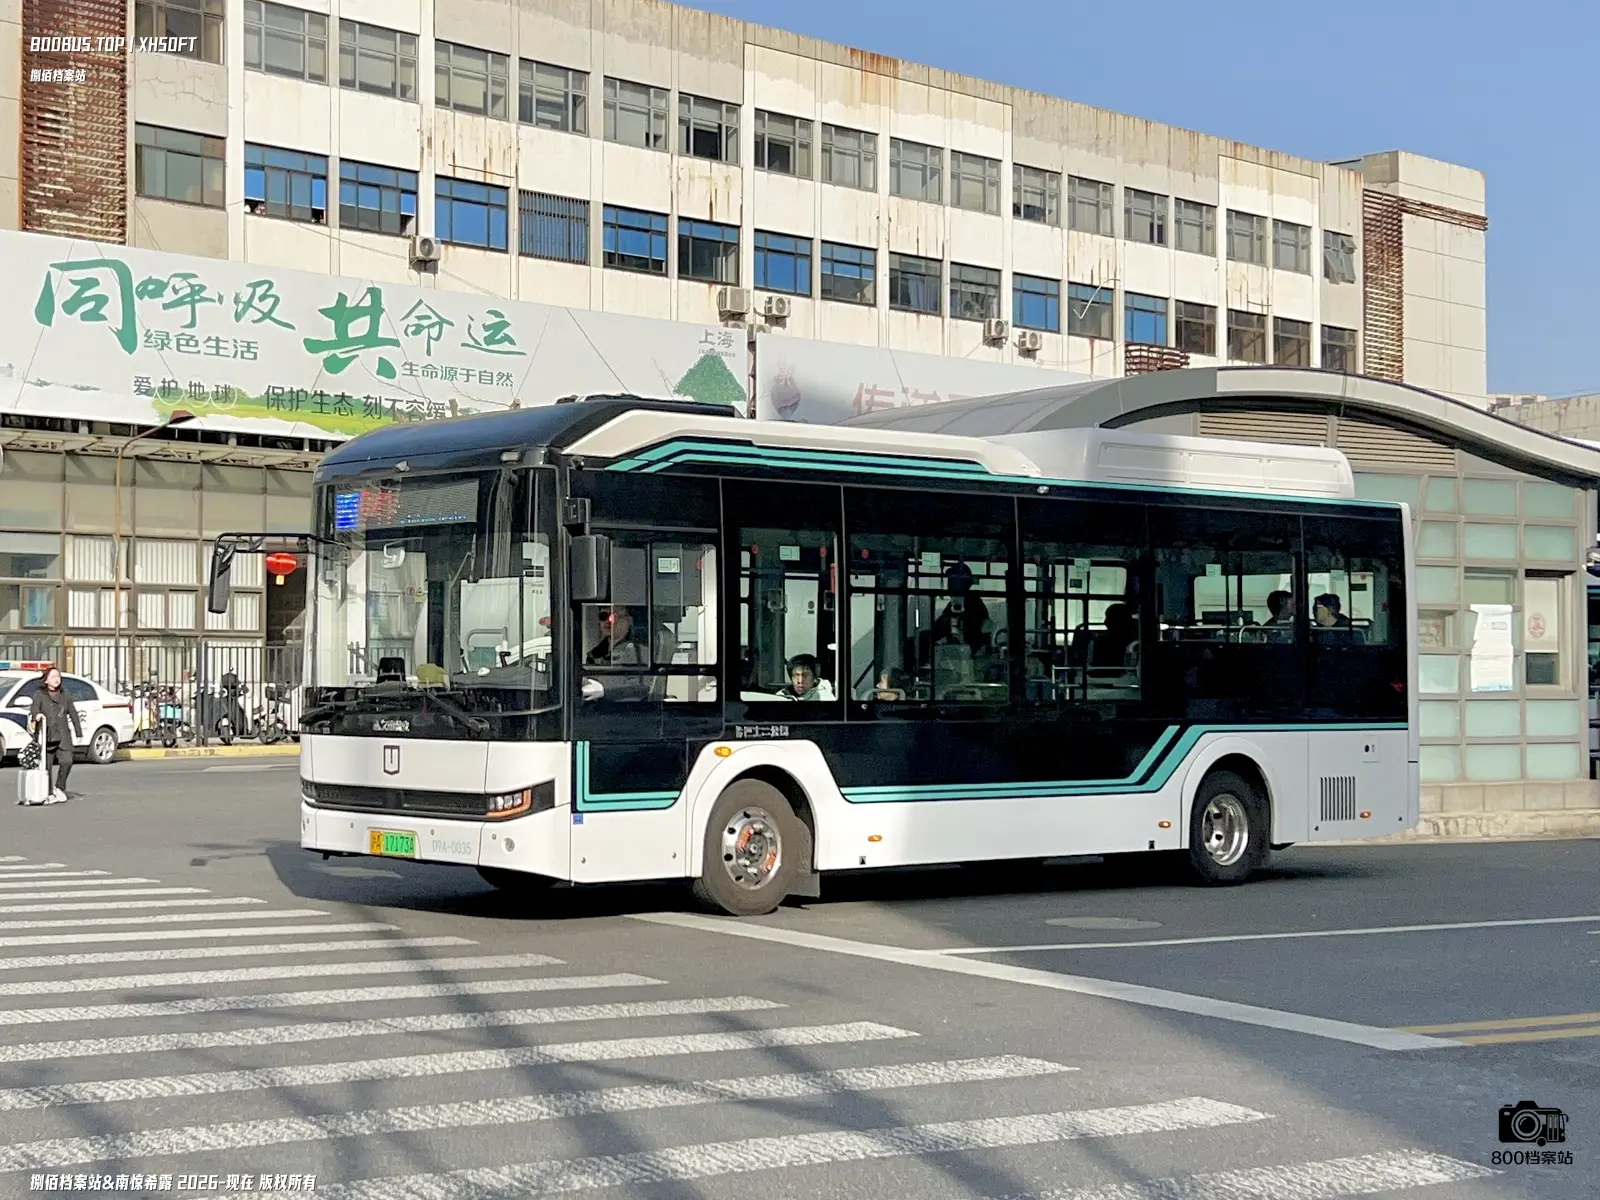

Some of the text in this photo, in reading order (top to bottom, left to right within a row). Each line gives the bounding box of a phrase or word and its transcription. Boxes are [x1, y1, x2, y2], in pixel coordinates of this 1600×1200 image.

[34, 258, 527, 379] 同呼吸 共命运
[143, 329, 259, 361] 绿色生活
[699, 328, 734, 348] 上海
[401, 361, 514, 388] 生命源于自然
[133, 375, 232, 404] 爱护地球
[265, 384, 354, 417] 保护生态
[432, 840, 472, 856] D9A-0035
